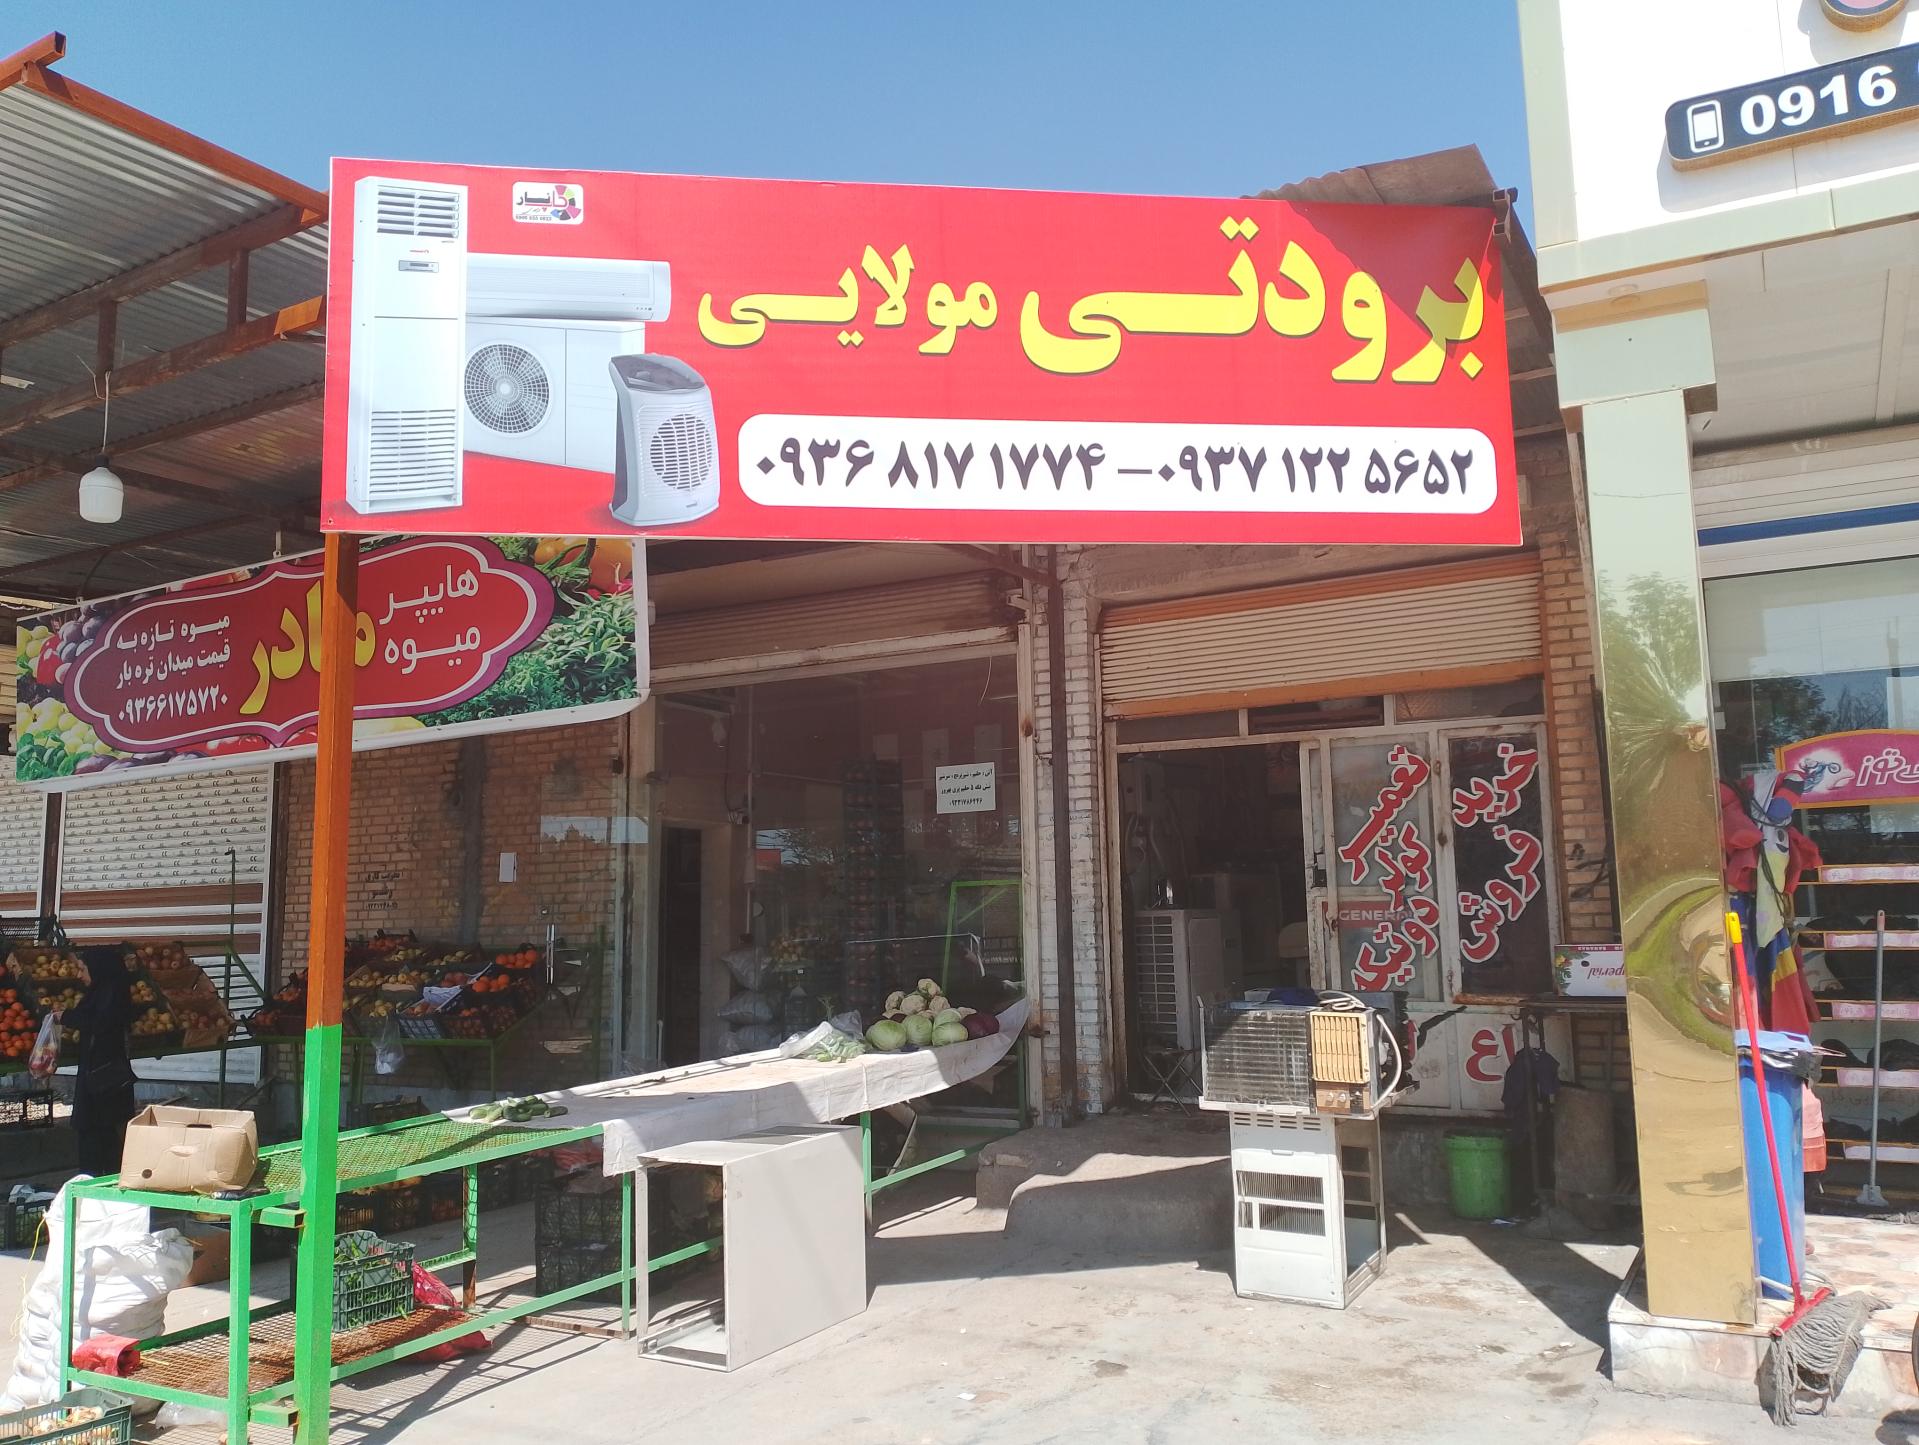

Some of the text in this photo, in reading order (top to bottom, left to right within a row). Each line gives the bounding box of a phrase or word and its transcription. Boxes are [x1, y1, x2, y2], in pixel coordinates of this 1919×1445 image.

[1740, 65, 1897, 136] 0916
[697, 215, 1484, 383] برودتی مولایی
[379, 564, 479, 625] هایپر
[116, 613, 230, 651] میوه تازه به
[116, 639, 231, 690] قیمت میدان تره بار
[384, 626, 481, 675] میوه
[118, 683, 229, 726] ۰۹۳۶۶۱۷۵۷۲۰
[1338, 744, 1430, 884] تعمیر
[1452, 743, 1539, 827] خرید
[1375, 821, 1432, 912] کولر
